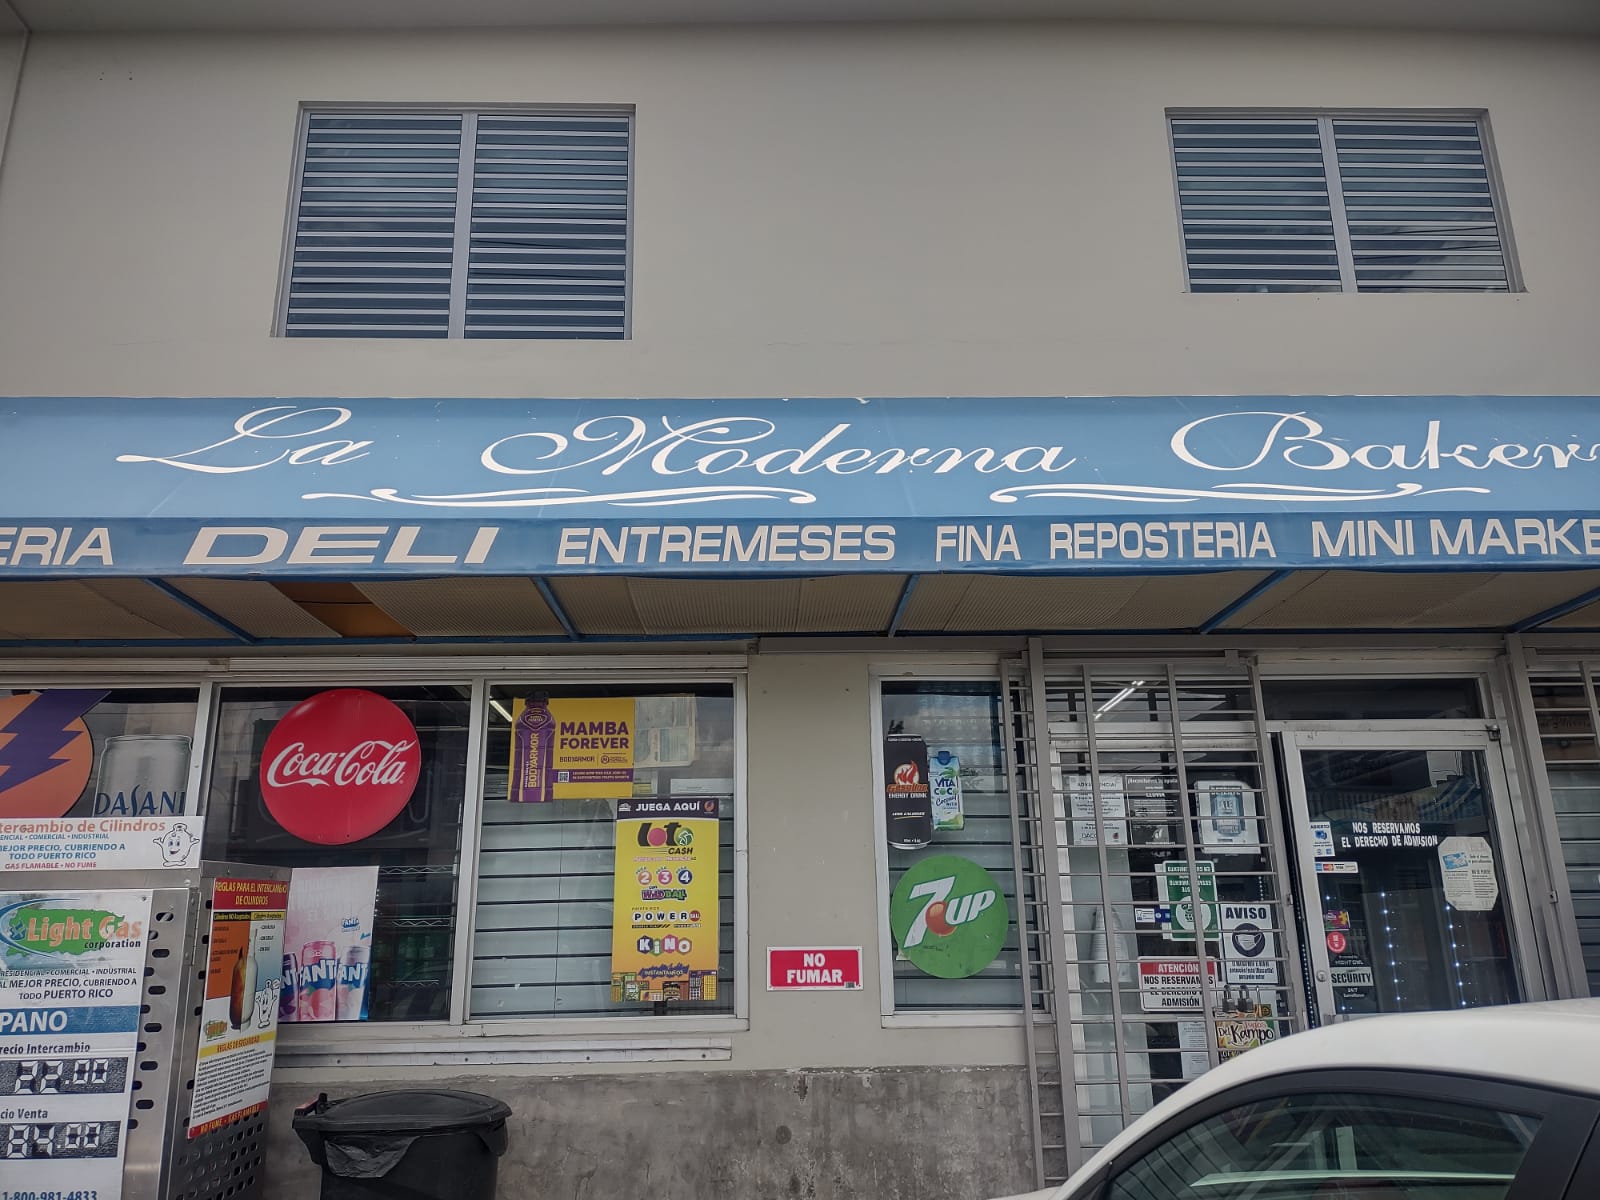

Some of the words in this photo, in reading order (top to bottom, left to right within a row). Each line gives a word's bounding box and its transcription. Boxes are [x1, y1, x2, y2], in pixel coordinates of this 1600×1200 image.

[116, 405, 374, 473] La
[480, 415, 1076, 476] Moderna
[1170, 410, 1600, 470] Baker
[182, 526, 499, 565] DELI
[556, 524, 896, 565] ENTREMESES
[935, 524, 1021, 562] FINA
[1050, 521, 1277, 561] REPOSTERIA
[1311, 519, 1415, 557] MINI
[560, 721, 629, 736] MAMBA
[560, 738, 629, 749] FOREVER
[267, 740, 416, 787] Coca-Cola
[527, 732, 540, 788] BODYARMOR
[934, 778, 956, 788] VITA
[95, 784, 187, 816] DASANI
[635, 803, 671, 812] JUEGA
[673, 801, 700, 812] AQUÍ
[77, 819, 96, 833] de
[99, 819, 166, 832] Cilindros
[1352, 822, 1368, 834] NOS
[1372, 822, 1421, 834] RESERVAMOS
[28, 844, 63, 852] PRECIO,
[65, 843, 117, 851] CUBRIENDO
[1341, 837, 1351, 848] EL
[1354, 836, 1388, 848] DERECHO
[1391, 835, 1402, 847] DE
[1404, 834, 1438, 847] ADMISION
[9, 852, 36, 860] TODO
[37, 852, 73, 860] PUERTO
[640, 871, 650, 884] 2
[660, 871, 671, 884] 3
[680, 870, 691, 883] 4
[1225, 907, 1267, 919] AVISO
[27, 916, 93, 947] Light
[99, 915, 142, 939] Gas
[84, 939, 141, 950] corporation
[803, 953, 826, 967] NO
[50, 968, 90, 976] COMERCIAL
[95, 967, 137, 975] INDUSTRIAL
[786, 969, 843, 984] FUMAR
[9, 979, 42, 989] MEJOR
[44, 977, 82, 988] PRECIO,
[83, 977, 130, 987] CUBRIENDO
[131, 977, 137, 986] A
[1143, 975, 1159, 985] NOS
[1161, 975, 1214, 985] RESERVAMS
[1331, 973, 1371, 984] SECURITY
[19, 992, 42, 1000] TODO
[43, 989, 86, 999] PUERTO
[88, 988, 114, 998] RICO
[1161, 995, 1200, 1007] ADMISIÓN
[1230, 1023, 1275, 1045] Kampo
[27, 1041, 91, 1055] Intercambio
[14, 1058, 109, 1094] 22.00
[18, 1108, 48, 1119] Venta
[6, 1122, 101, 1159] 84.00
[2, 1190, 98, 1200] 1-800-981-4833
